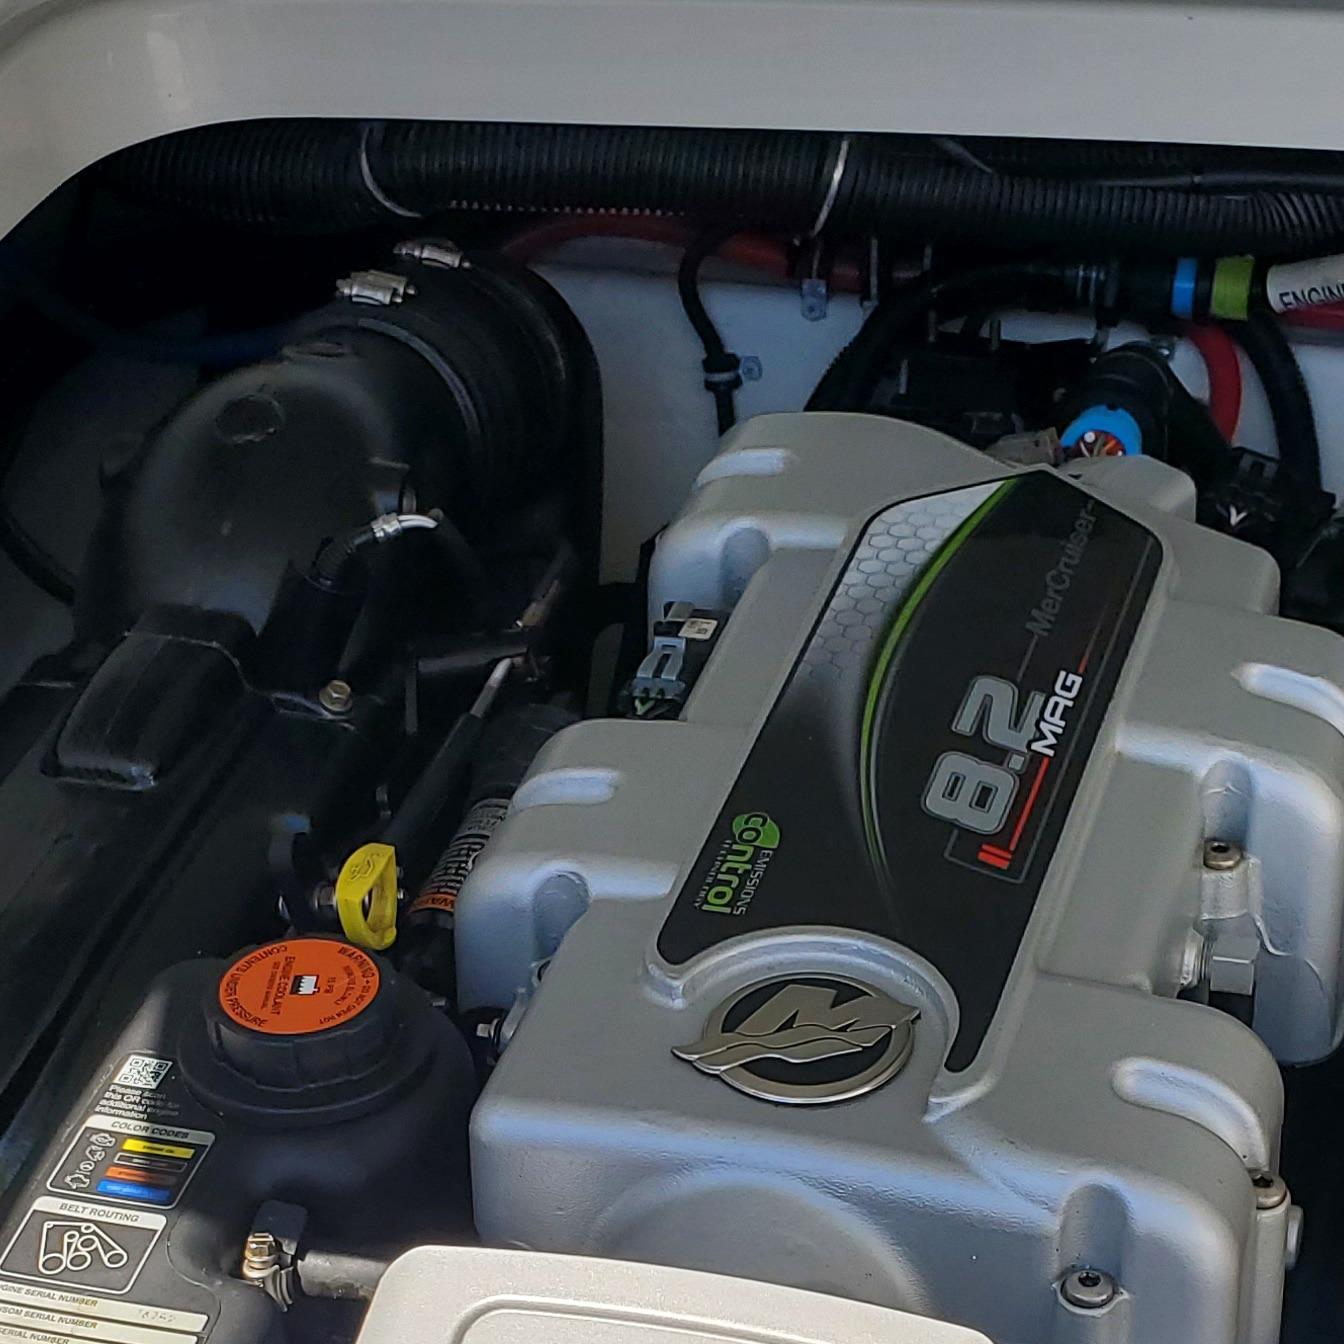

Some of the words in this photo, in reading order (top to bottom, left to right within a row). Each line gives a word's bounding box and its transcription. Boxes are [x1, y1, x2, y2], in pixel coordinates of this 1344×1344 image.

[1025, 510, 1097, 637] MerCruiser
[1031, 670, 1083, 757] MAG
[920, 675, 1046, 835] 8.2
[701, 812, 769, 914] control
[733, 849, 774, 915] EMISSIONS
[104, 1091, 123, 1100] this
[123, 1095, 142, 1104] QR
[108, 1084, 142, 1096] Please
[111, 1121, 150, 1133] COLOR
[151, 1127, 190, 1140] CODES
[59, 1203, 87, 1214] BELT
[89, 1208, 140, 1223] ROUTING
[24, 1288, 57, 1300] SERIAL
[58, 1295, 98, 1307] NUMBER
[24, 1310, 56, 1322] SERIAL
[57, 1316, 98, 1329] NUMBER
